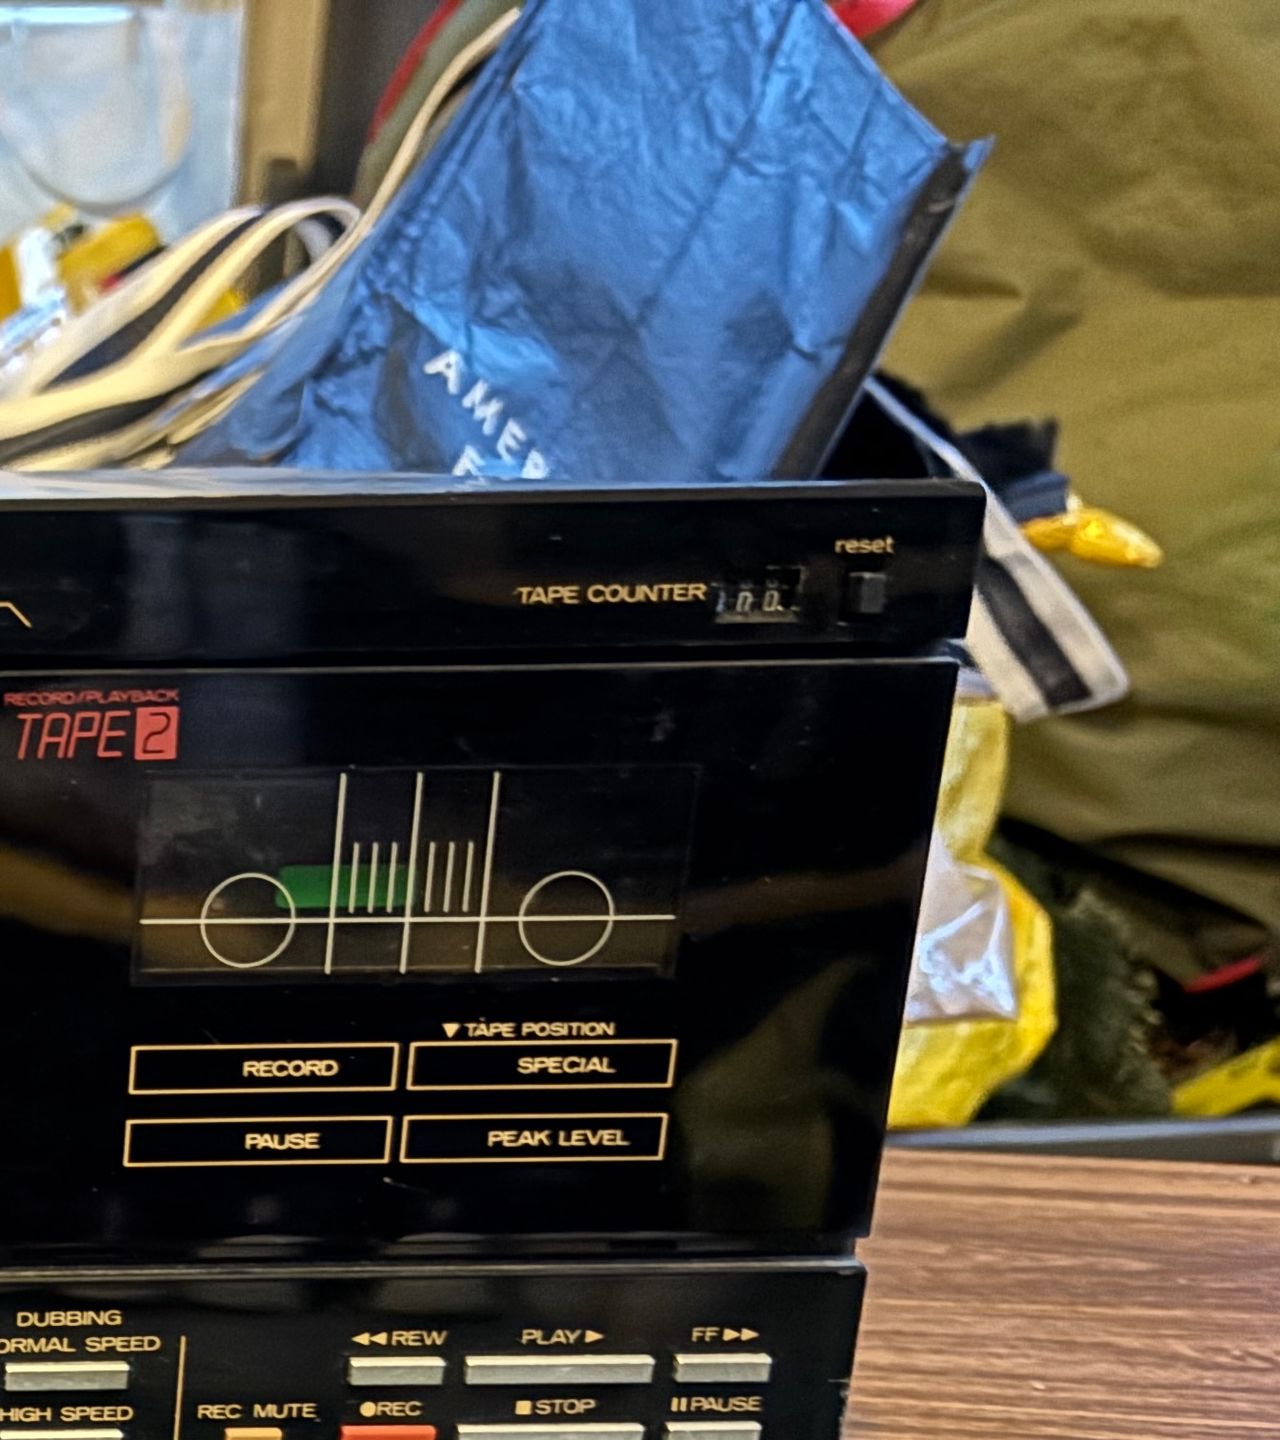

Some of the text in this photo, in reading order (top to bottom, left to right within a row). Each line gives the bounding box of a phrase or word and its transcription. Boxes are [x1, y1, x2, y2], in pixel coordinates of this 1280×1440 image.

[835, 536, 895, 554] reset
[517, 583, 707, 605] TAPE COUNTER
[4, 689, 180, 707] RECORD/PLAYBACK
[17, 711, 130, 760] TAPE
[466, 1021, 616, 1038] TAPE POSITION
[243, 1060, 339, 1078] RECORD
[517, 1057, 616, 1075] SPECIAL
[245, 1133, 321, 1151] PAUSE
[488, 1128, 631, 1148] PEAK LEVEL
[16, 1310, 122, 1328] DUBBING
[391, 1330, 447, 1347] REW
[521, 1328, 581, 1346] PLAY
[691, 1326, 719, 1342] FF
[85, 1335, 161, 1353] SPEED
[60, 1405, 134, 1422] SPEED
[197, 1402, 316, 1420] REC MUTE
[377, 1401, 422, 1417] REC
[535, 1399, 597, 1416] STOP
[689, 1396, 763, 1413] PAUSE
